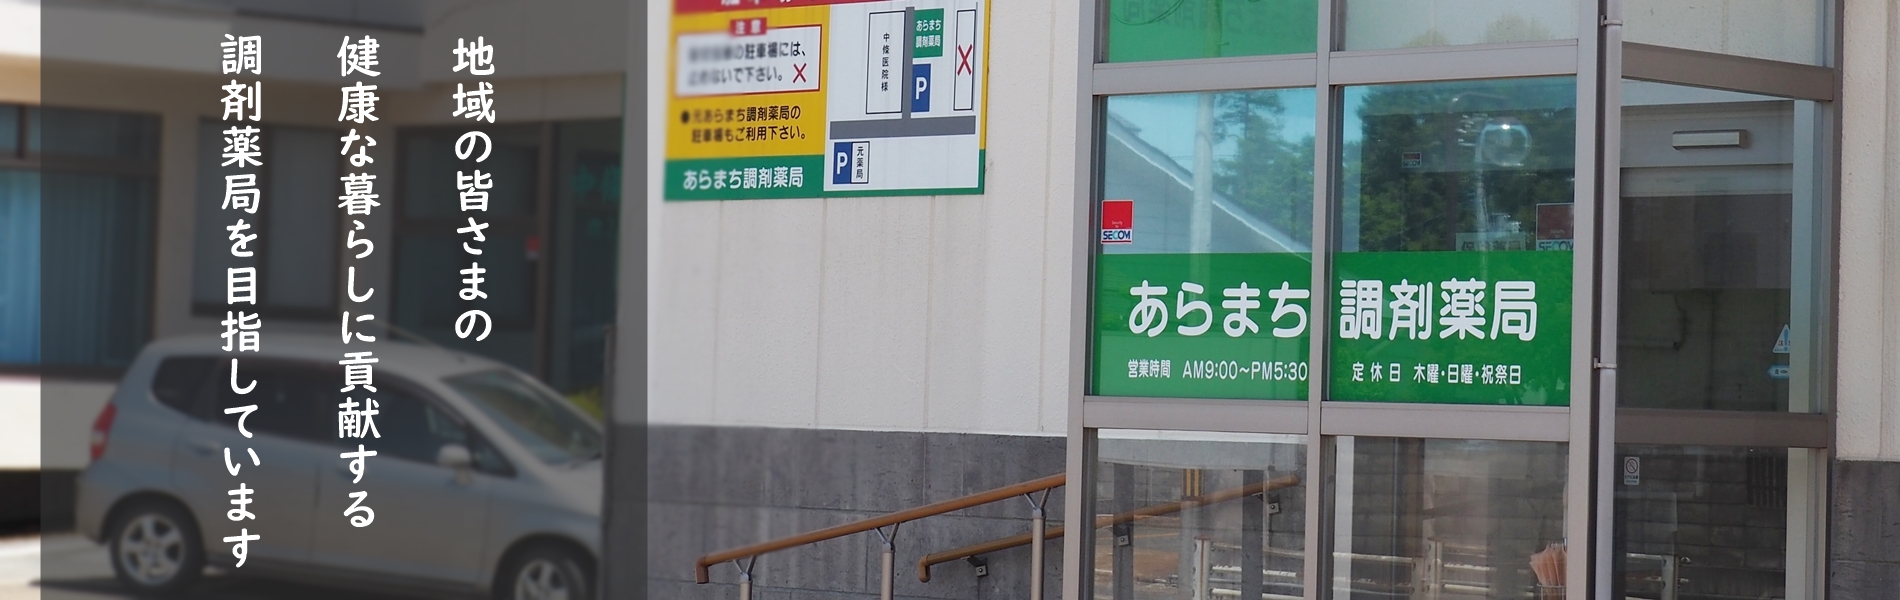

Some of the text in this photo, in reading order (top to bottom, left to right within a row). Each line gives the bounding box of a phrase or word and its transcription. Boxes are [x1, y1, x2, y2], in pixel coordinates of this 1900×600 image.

[915, 19, 942, 32] あらまち
[915, 76, 928, 100] P
[836, 151, 848, 175] P
[856, 146, 864, 179] 元薬局
[683, 166, 803, 190] あらまち調剤薬局
[1102, 230, 1131, 240] SECOM
[1129, 277, 1538, 341] あらまち 調剤薬局
[1128, 359, 1171, 379] 営業時間
[1413, 363, 1521, 384] 木曜・日曜・祝祭日
